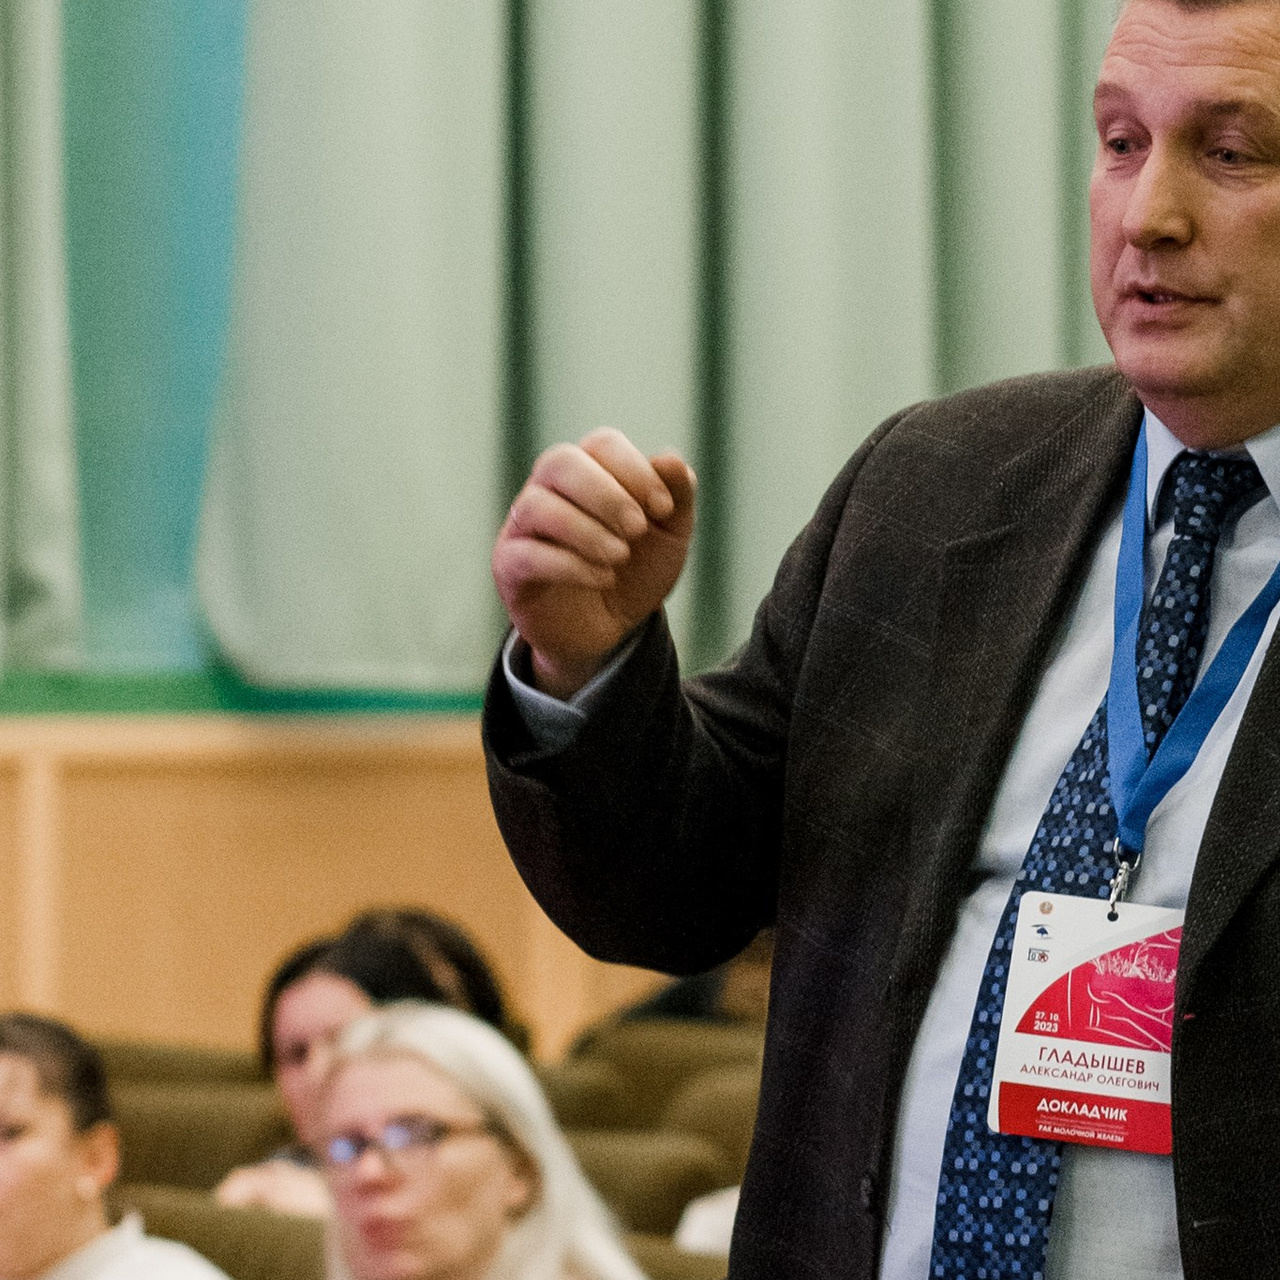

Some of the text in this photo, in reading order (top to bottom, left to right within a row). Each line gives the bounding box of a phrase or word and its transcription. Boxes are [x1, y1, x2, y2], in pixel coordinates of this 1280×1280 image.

[1033, 1020, 1059, 1033] 2023
[1038, 1046, 1146, 1075] ГЛАДЫШЕВ
[1020, 1063, 1160, 1092] АЛЕКСАНДР ОЛЕГОВИЧ
[1036, 1097, 1128, 1122] ДОКЛАДЧИК
[1038, 1124, 1052, 1133] РАК
[1053, 1125, 1096, 1140] МОЛОЧНОЙ
[1096, 1131, 1125, 1143] ЖЕЛЕЗЫ
